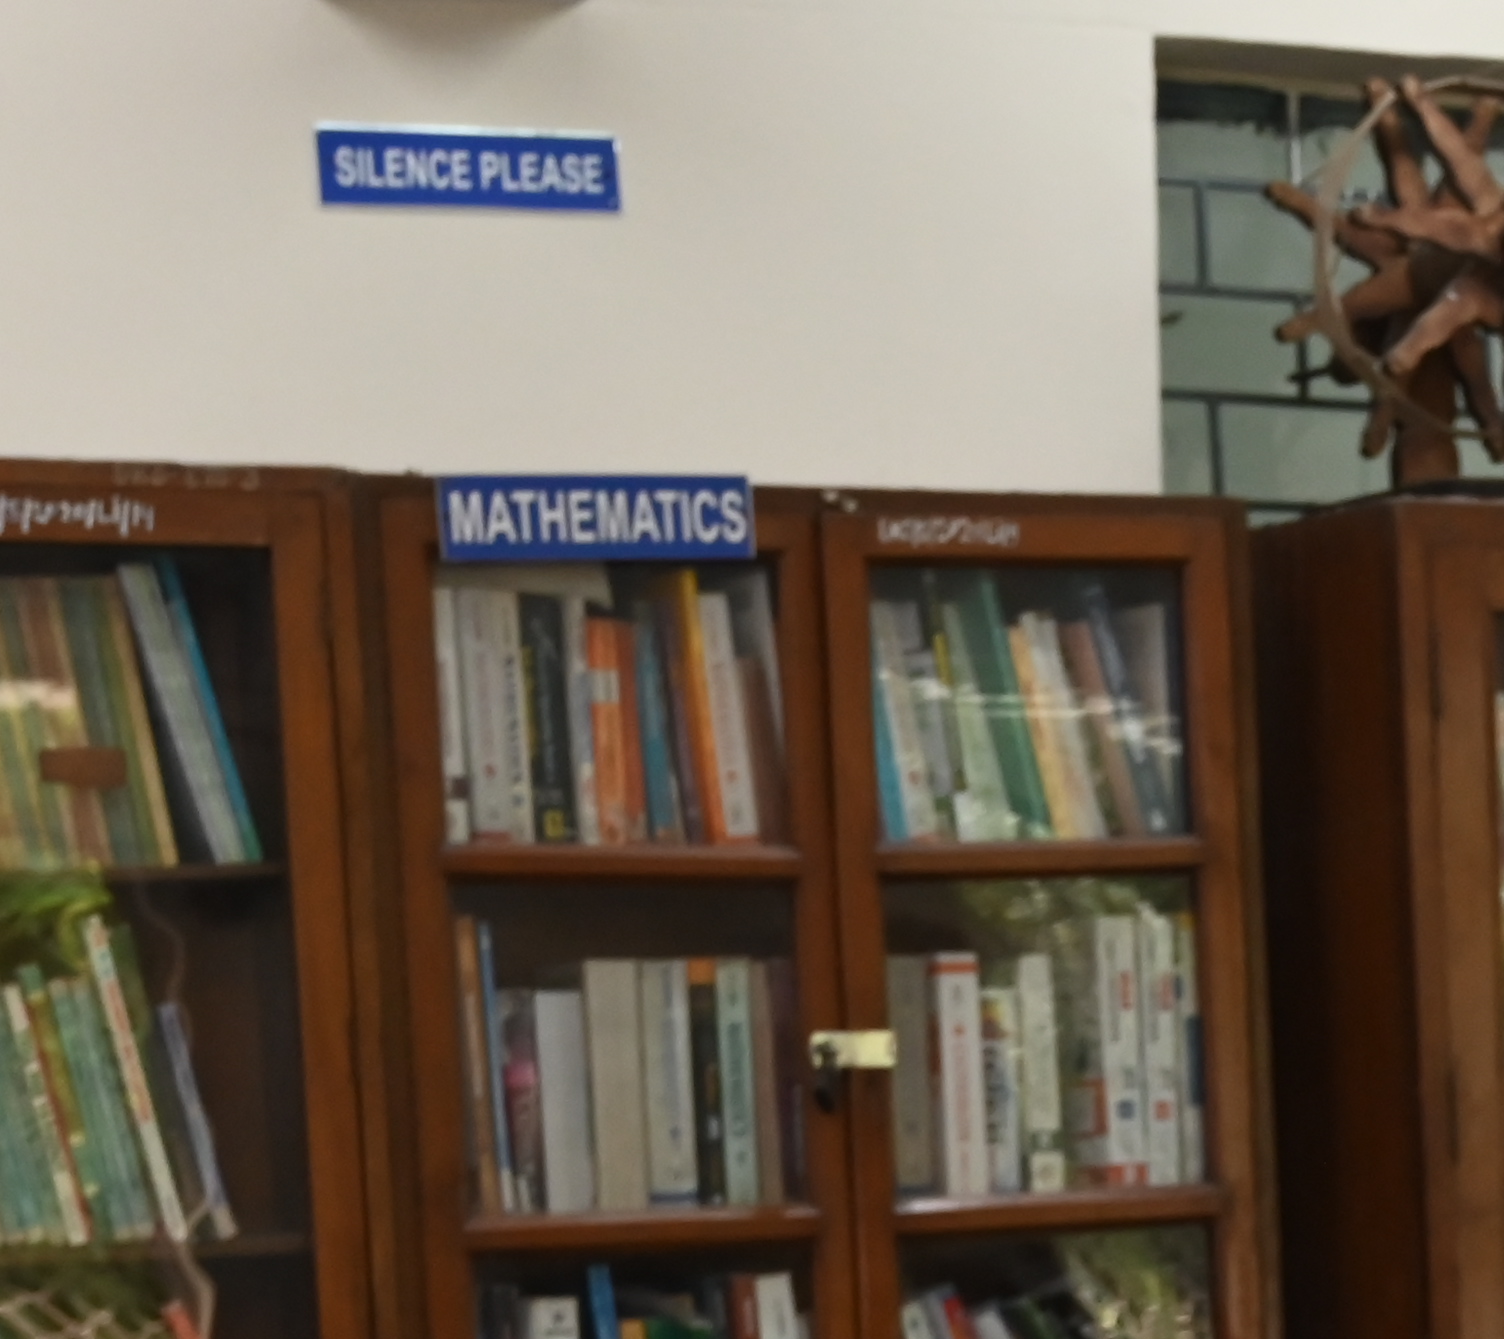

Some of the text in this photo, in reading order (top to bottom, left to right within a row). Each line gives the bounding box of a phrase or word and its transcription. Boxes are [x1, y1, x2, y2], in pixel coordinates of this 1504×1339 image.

[335, 147, 603, 193] SILENCE PLEASE
[449, 490, 748, 543] MATHEMATICS
